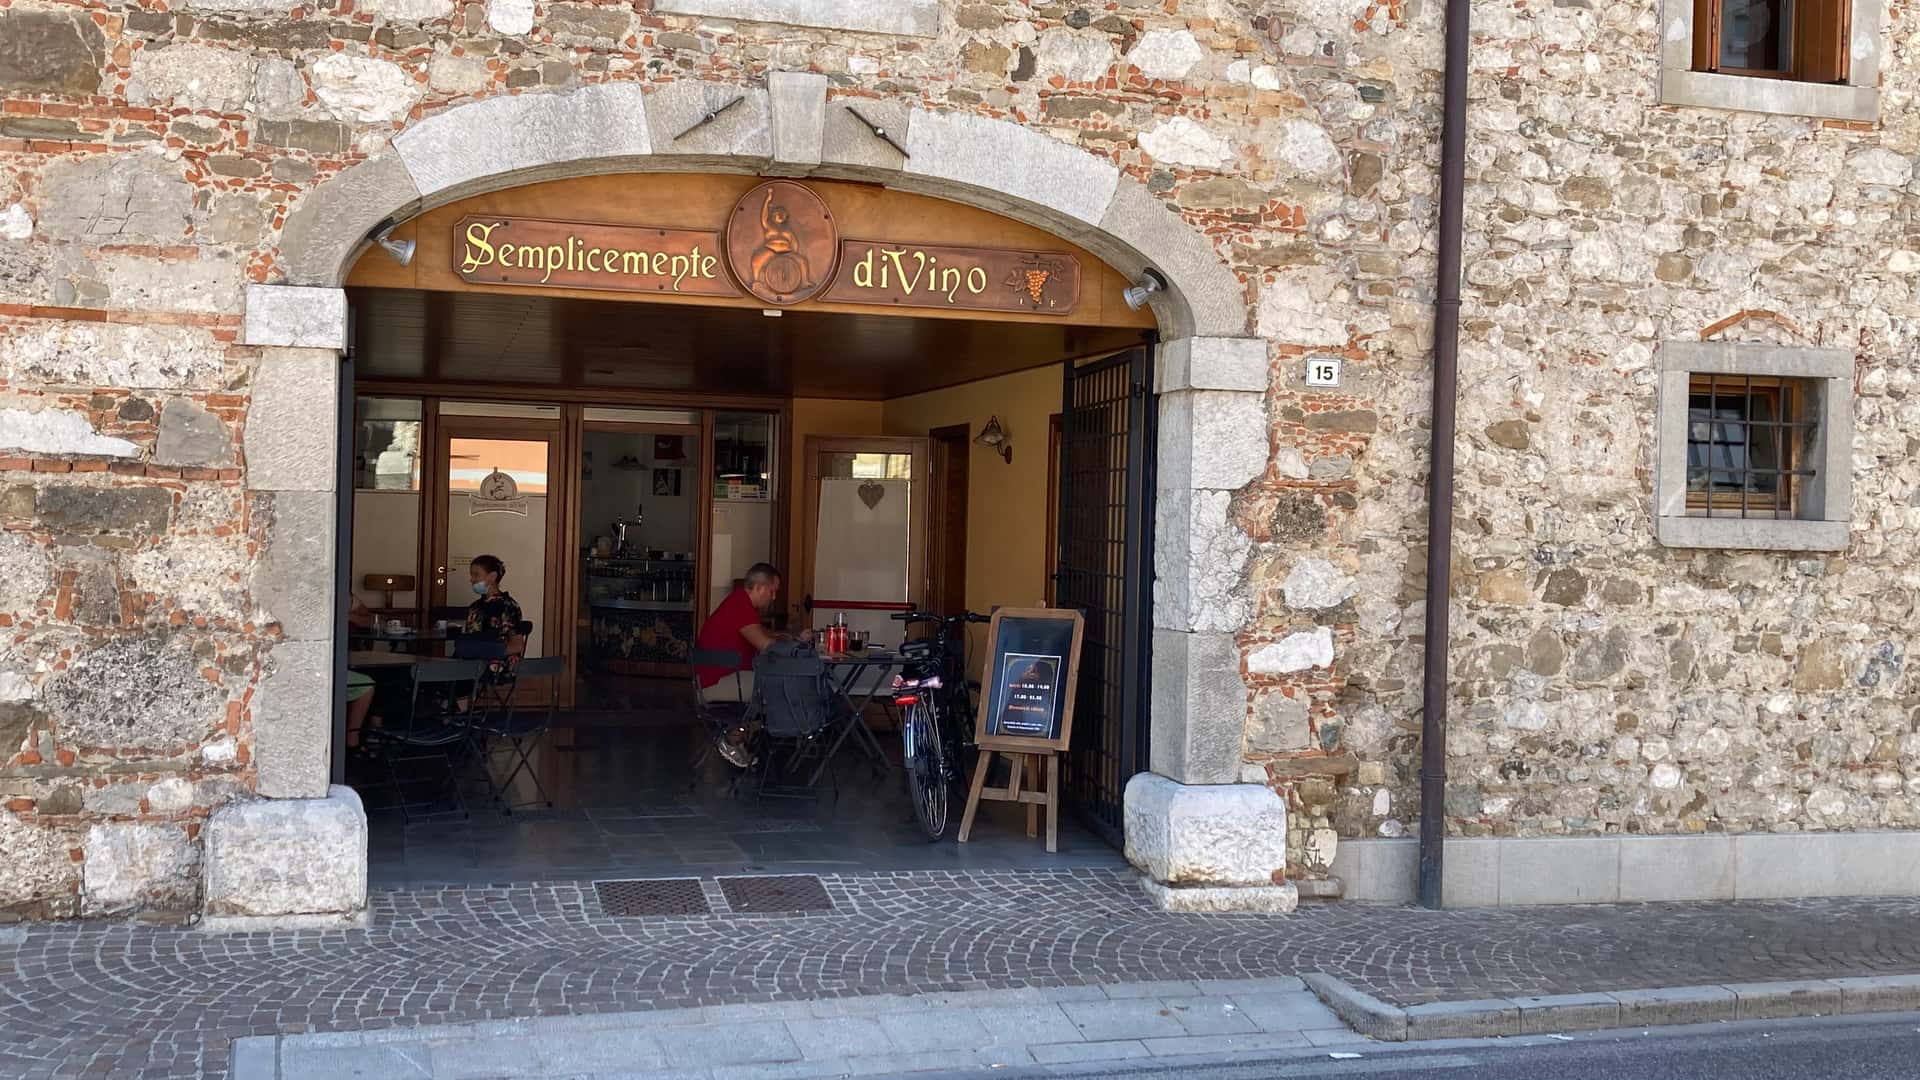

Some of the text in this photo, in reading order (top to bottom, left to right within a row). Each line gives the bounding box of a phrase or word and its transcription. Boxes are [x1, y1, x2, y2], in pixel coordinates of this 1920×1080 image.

[461, 222, 987, 303] Semplicemente diVino
[1315, 365, 1333, 381] 15
